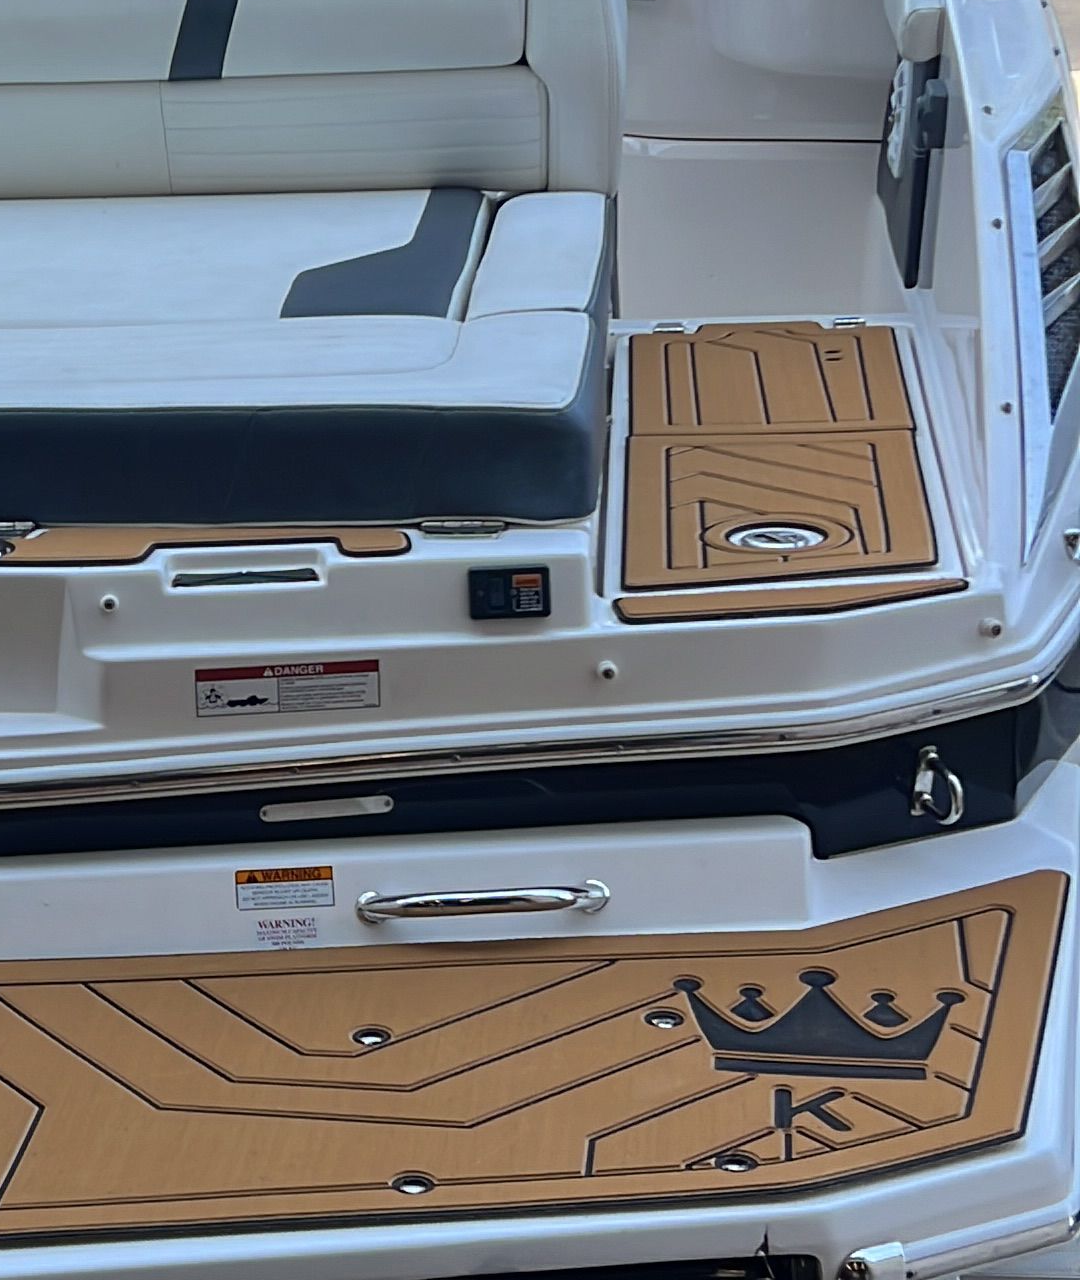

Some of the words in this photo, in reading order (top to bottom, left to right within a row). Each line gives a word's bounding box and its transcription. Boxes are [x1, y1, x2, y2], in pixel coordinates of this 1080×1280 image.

[274, 664, 324, 677] DANGER
[260, 867, 322, 882] WARNING
[257, 917, 316, 929] WARNING!
[774, 1087, 852, 1132] K
